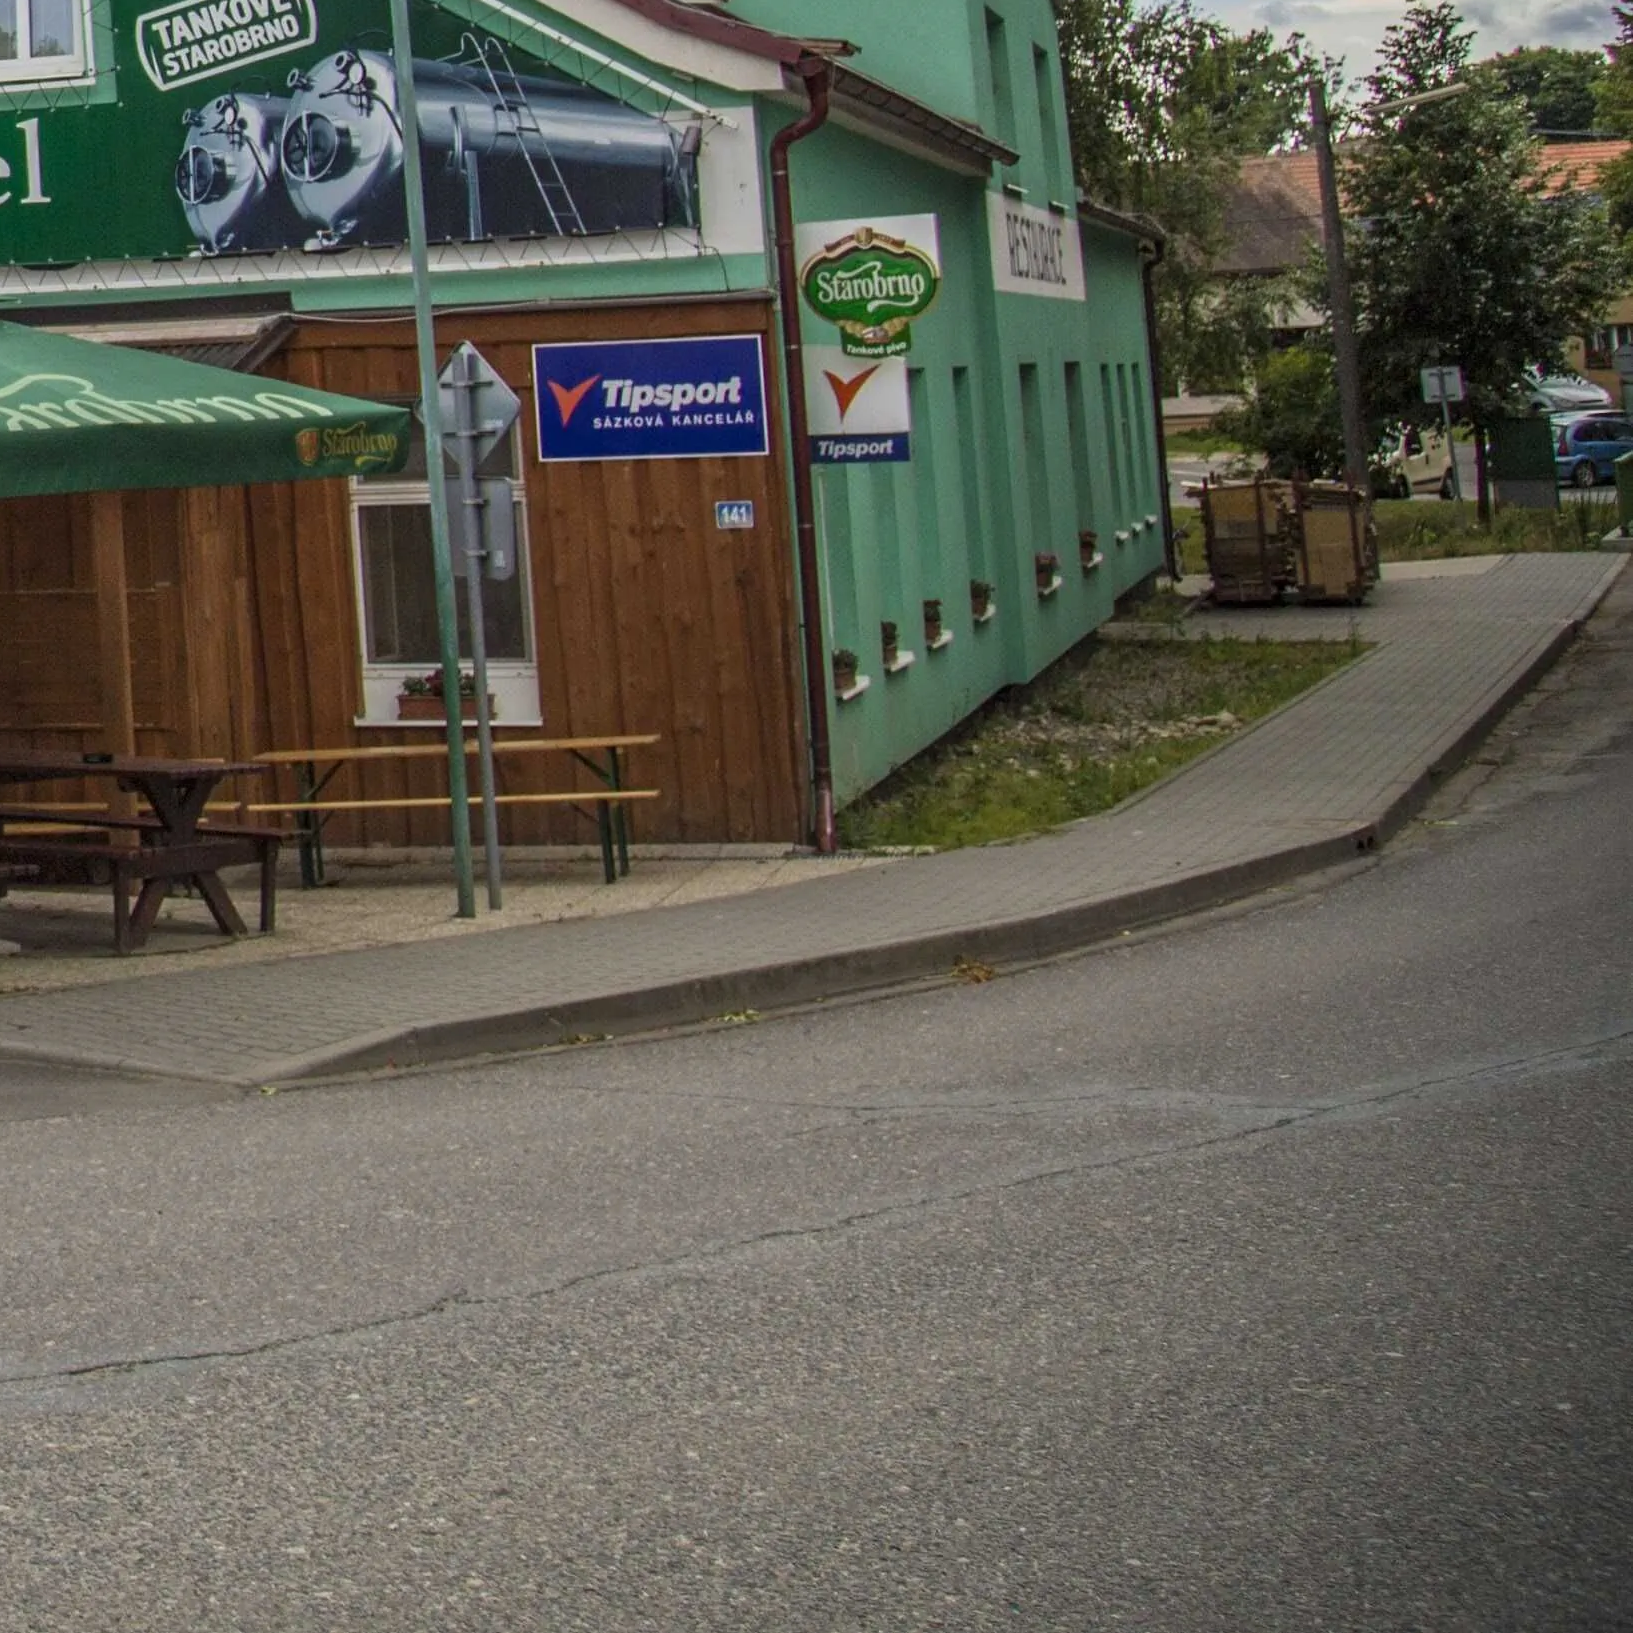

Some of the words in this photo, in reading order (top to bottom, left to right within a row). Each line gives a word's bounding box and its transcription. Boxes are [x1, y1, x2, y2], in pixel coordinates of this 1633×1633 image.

[162, 14, 300, 76] STAROBRNO
[817, 261, 925, 312] Starobrno
[602, 376, 742, 413] Tipsport
[593, 413, 664, 429] SÁZKOVÁ
[672, 409, 755, 426] KANCELÁŘ
[322, 421, 398, 466] Starobrno
[818, 439, 894, 459] Tipsport
[721, 505, 746, 524] 141
